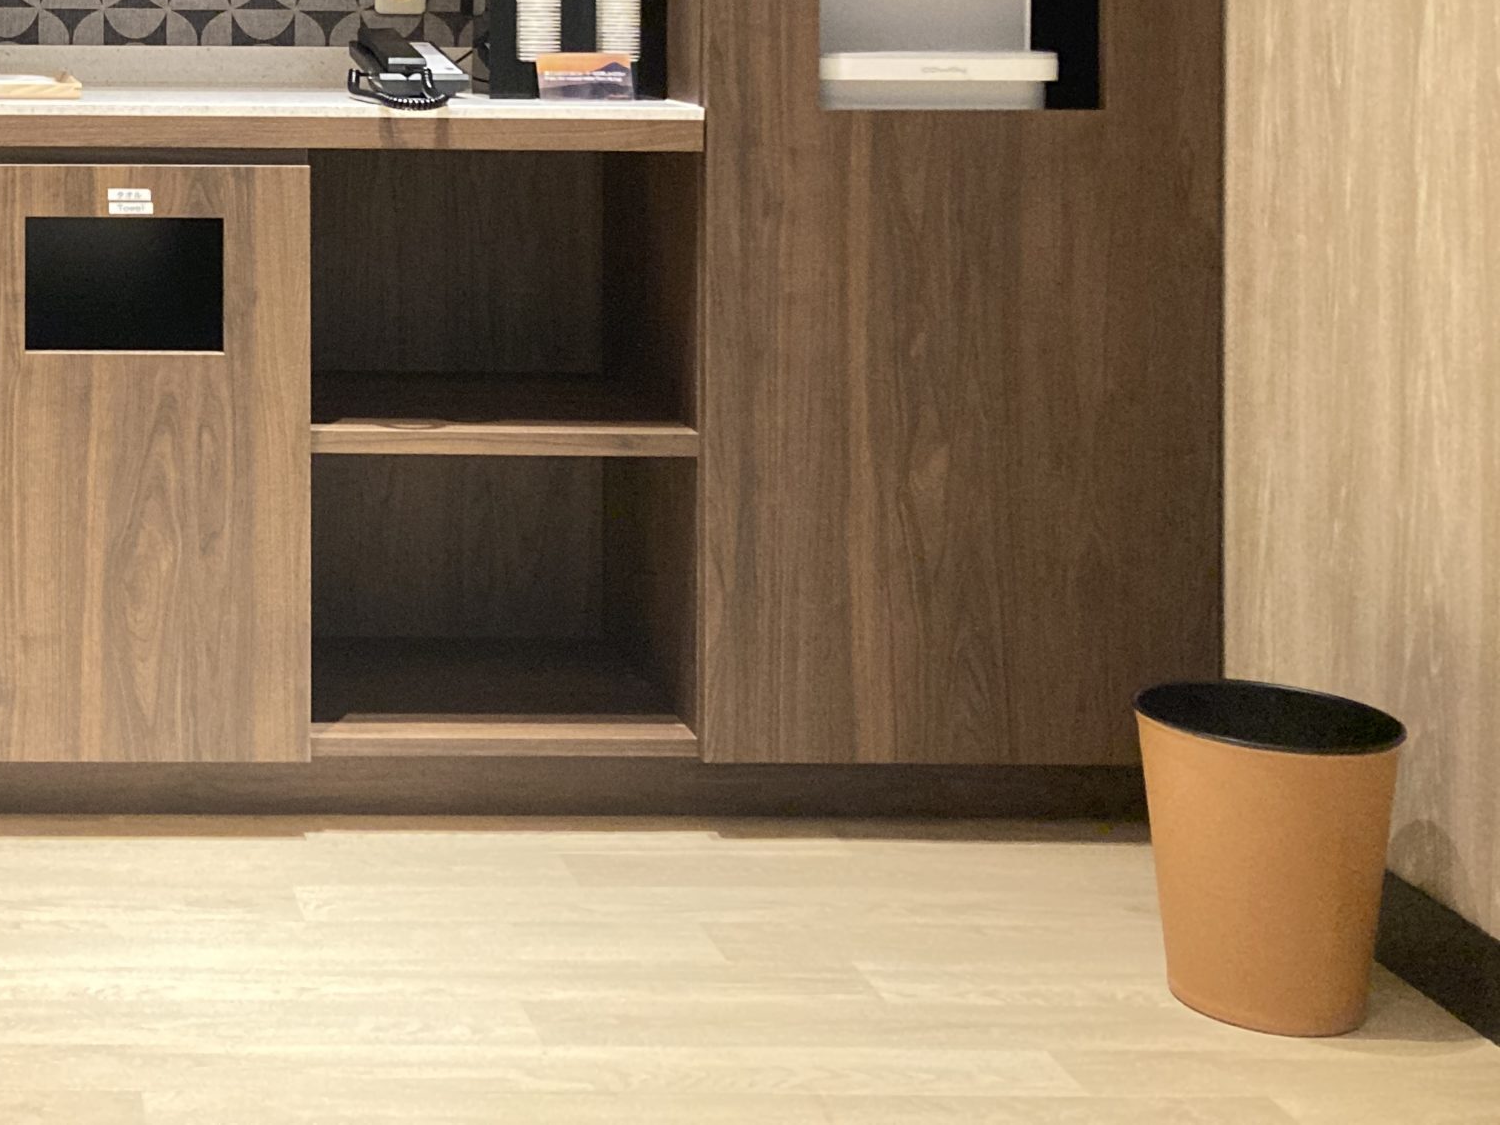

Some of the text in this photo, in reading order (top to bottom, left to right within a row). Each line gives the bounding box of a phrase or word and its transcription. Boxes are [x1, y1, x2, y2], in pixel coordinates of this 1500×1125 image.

[116, 190, 142, 200] タオル
[116, 203, 145, 212] Towel
